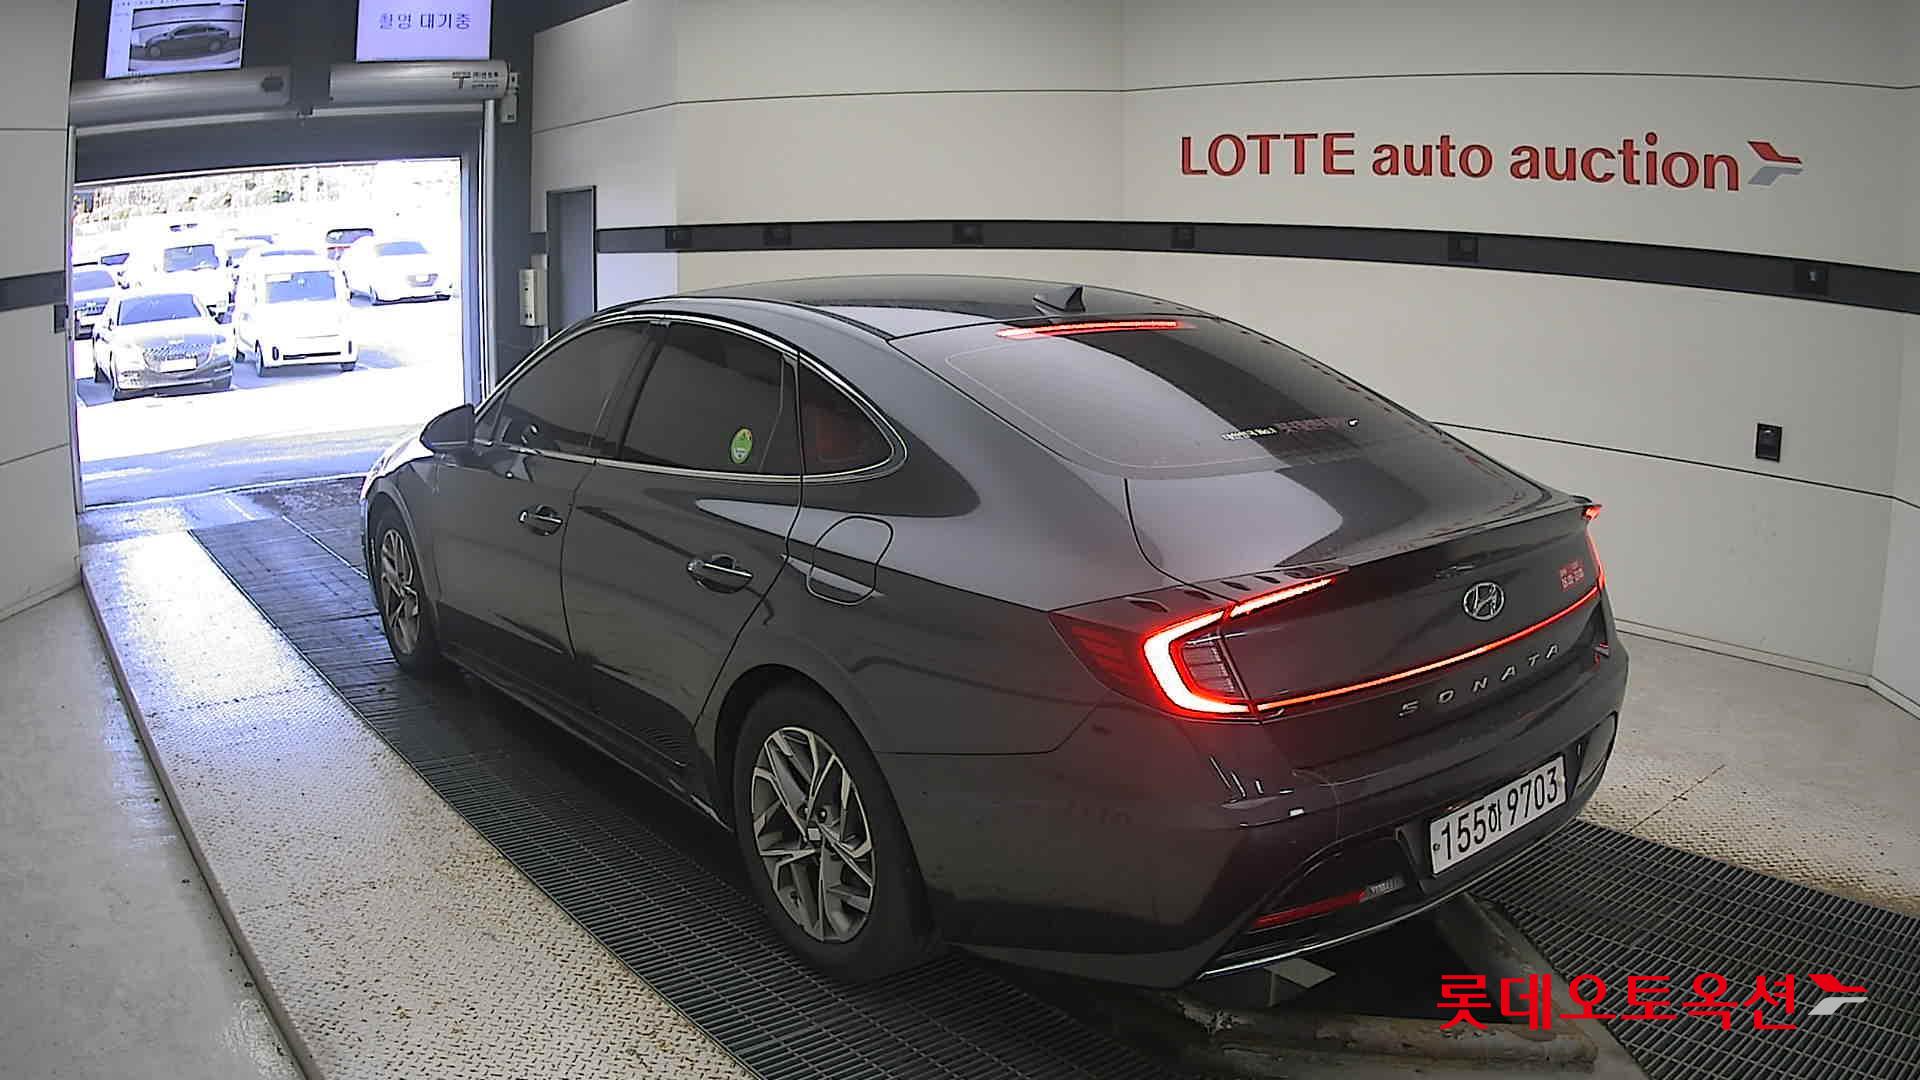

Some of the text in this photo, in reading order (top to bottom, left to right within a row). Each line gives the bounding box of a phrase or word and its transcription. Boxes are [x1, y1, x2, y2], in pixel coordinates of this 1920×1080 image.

[420, 13, 473, 30] 대기중
[1181, 132, 1740, 191] LOTTE auto auction
[1399, 643, 1560, 717] SONATA
